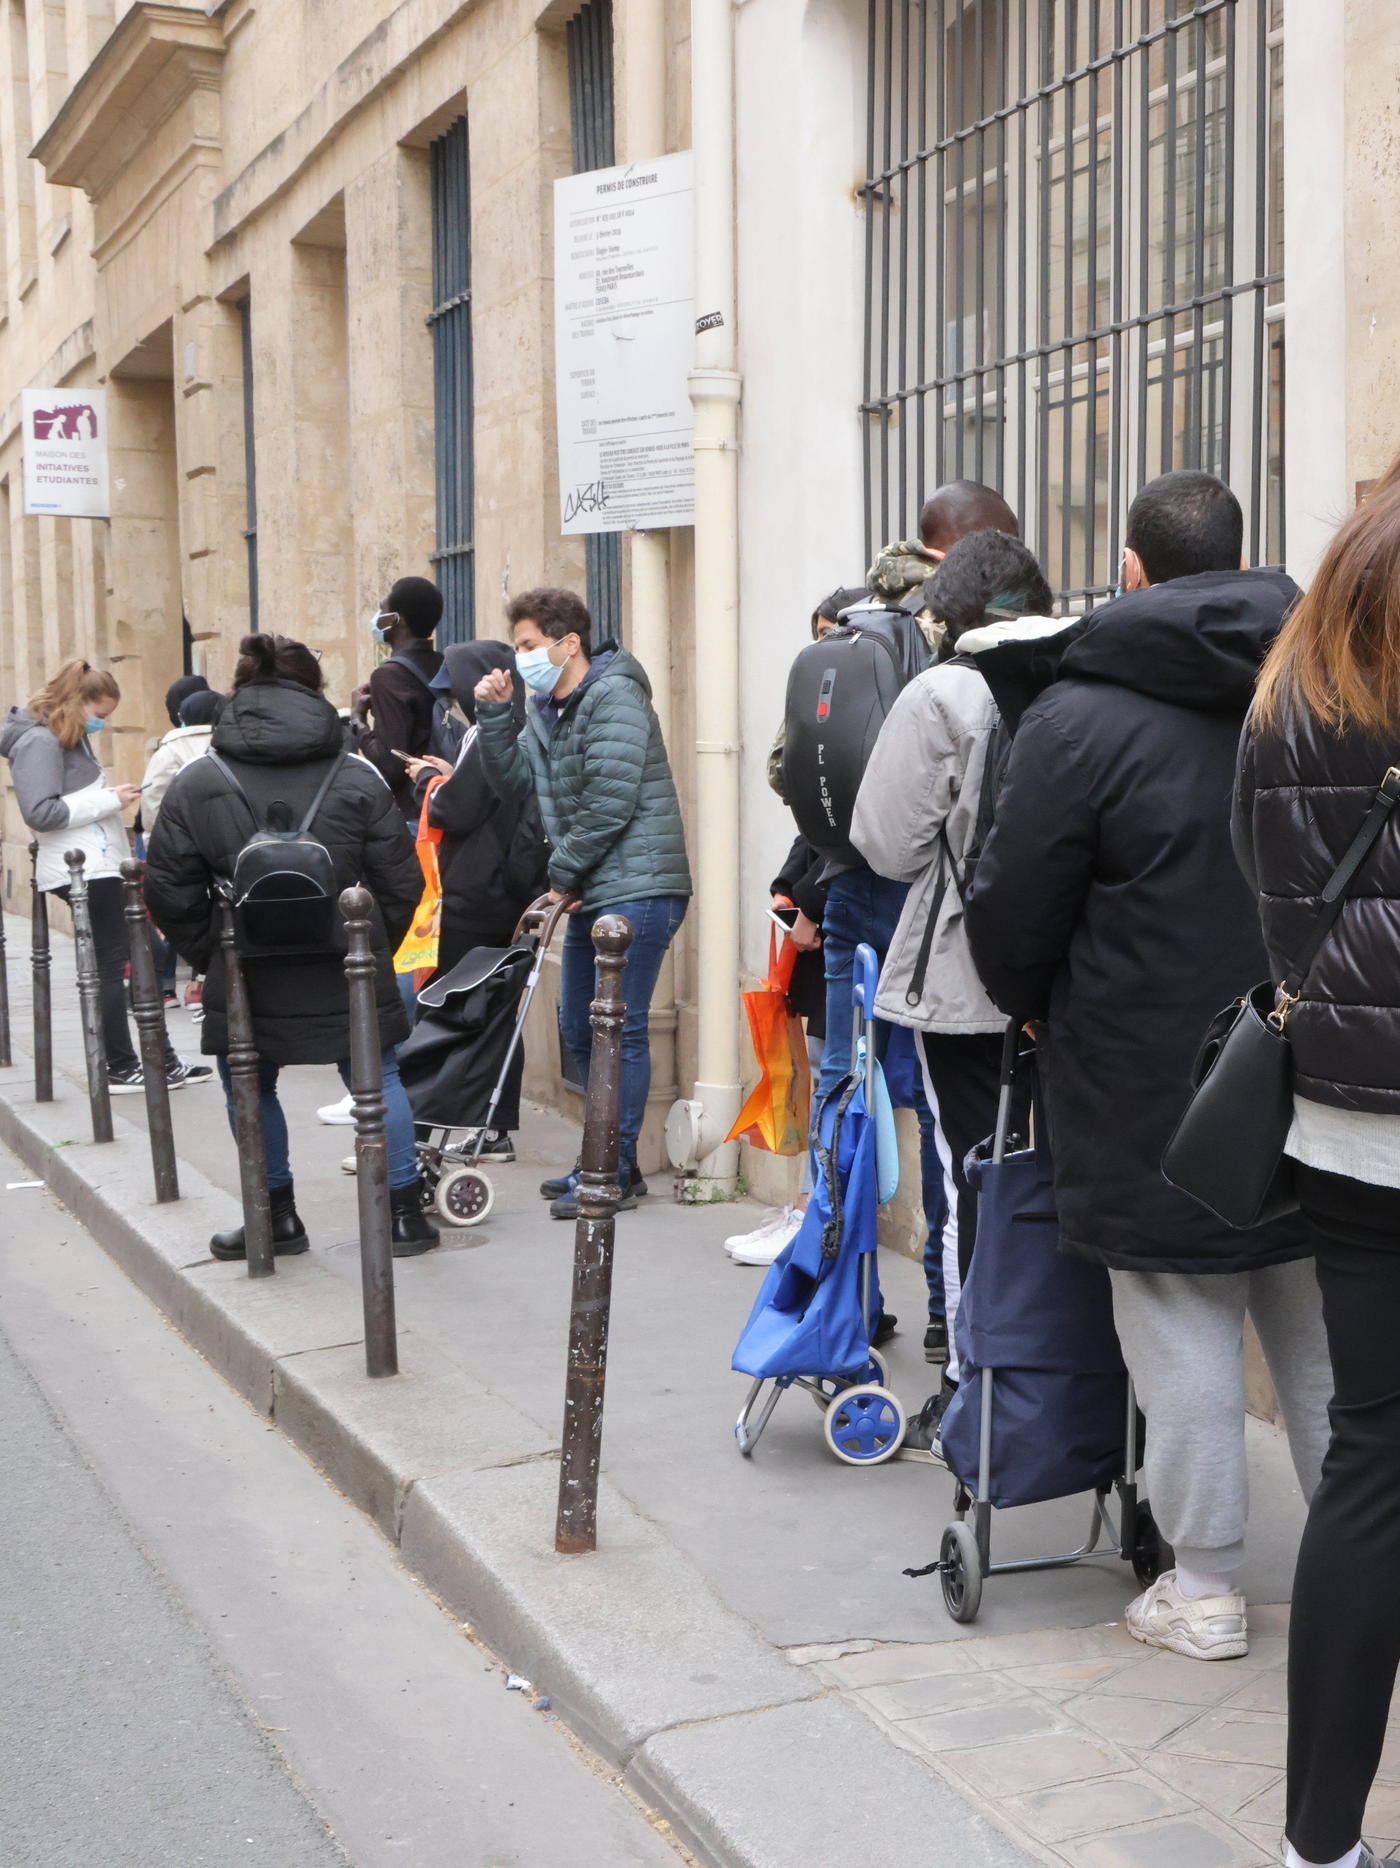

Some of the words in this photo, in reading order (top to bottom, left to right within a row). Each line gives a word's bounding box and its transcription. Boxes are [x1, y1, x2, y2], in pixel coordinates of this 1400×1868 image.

[596, 182, 617, 194] PERMIS
[617, 180, 625, 191] DE
[625, 173, 658, 189] CONSTRUIRE
[35, 450, 68, 458] MAISON
[69, 451, 87, 459] DES
[36, 463, 90, 472] INITIATIVES
[36, 475, 98, 485] ETUDIANTES
[820, 776, 836, 827] POWER
